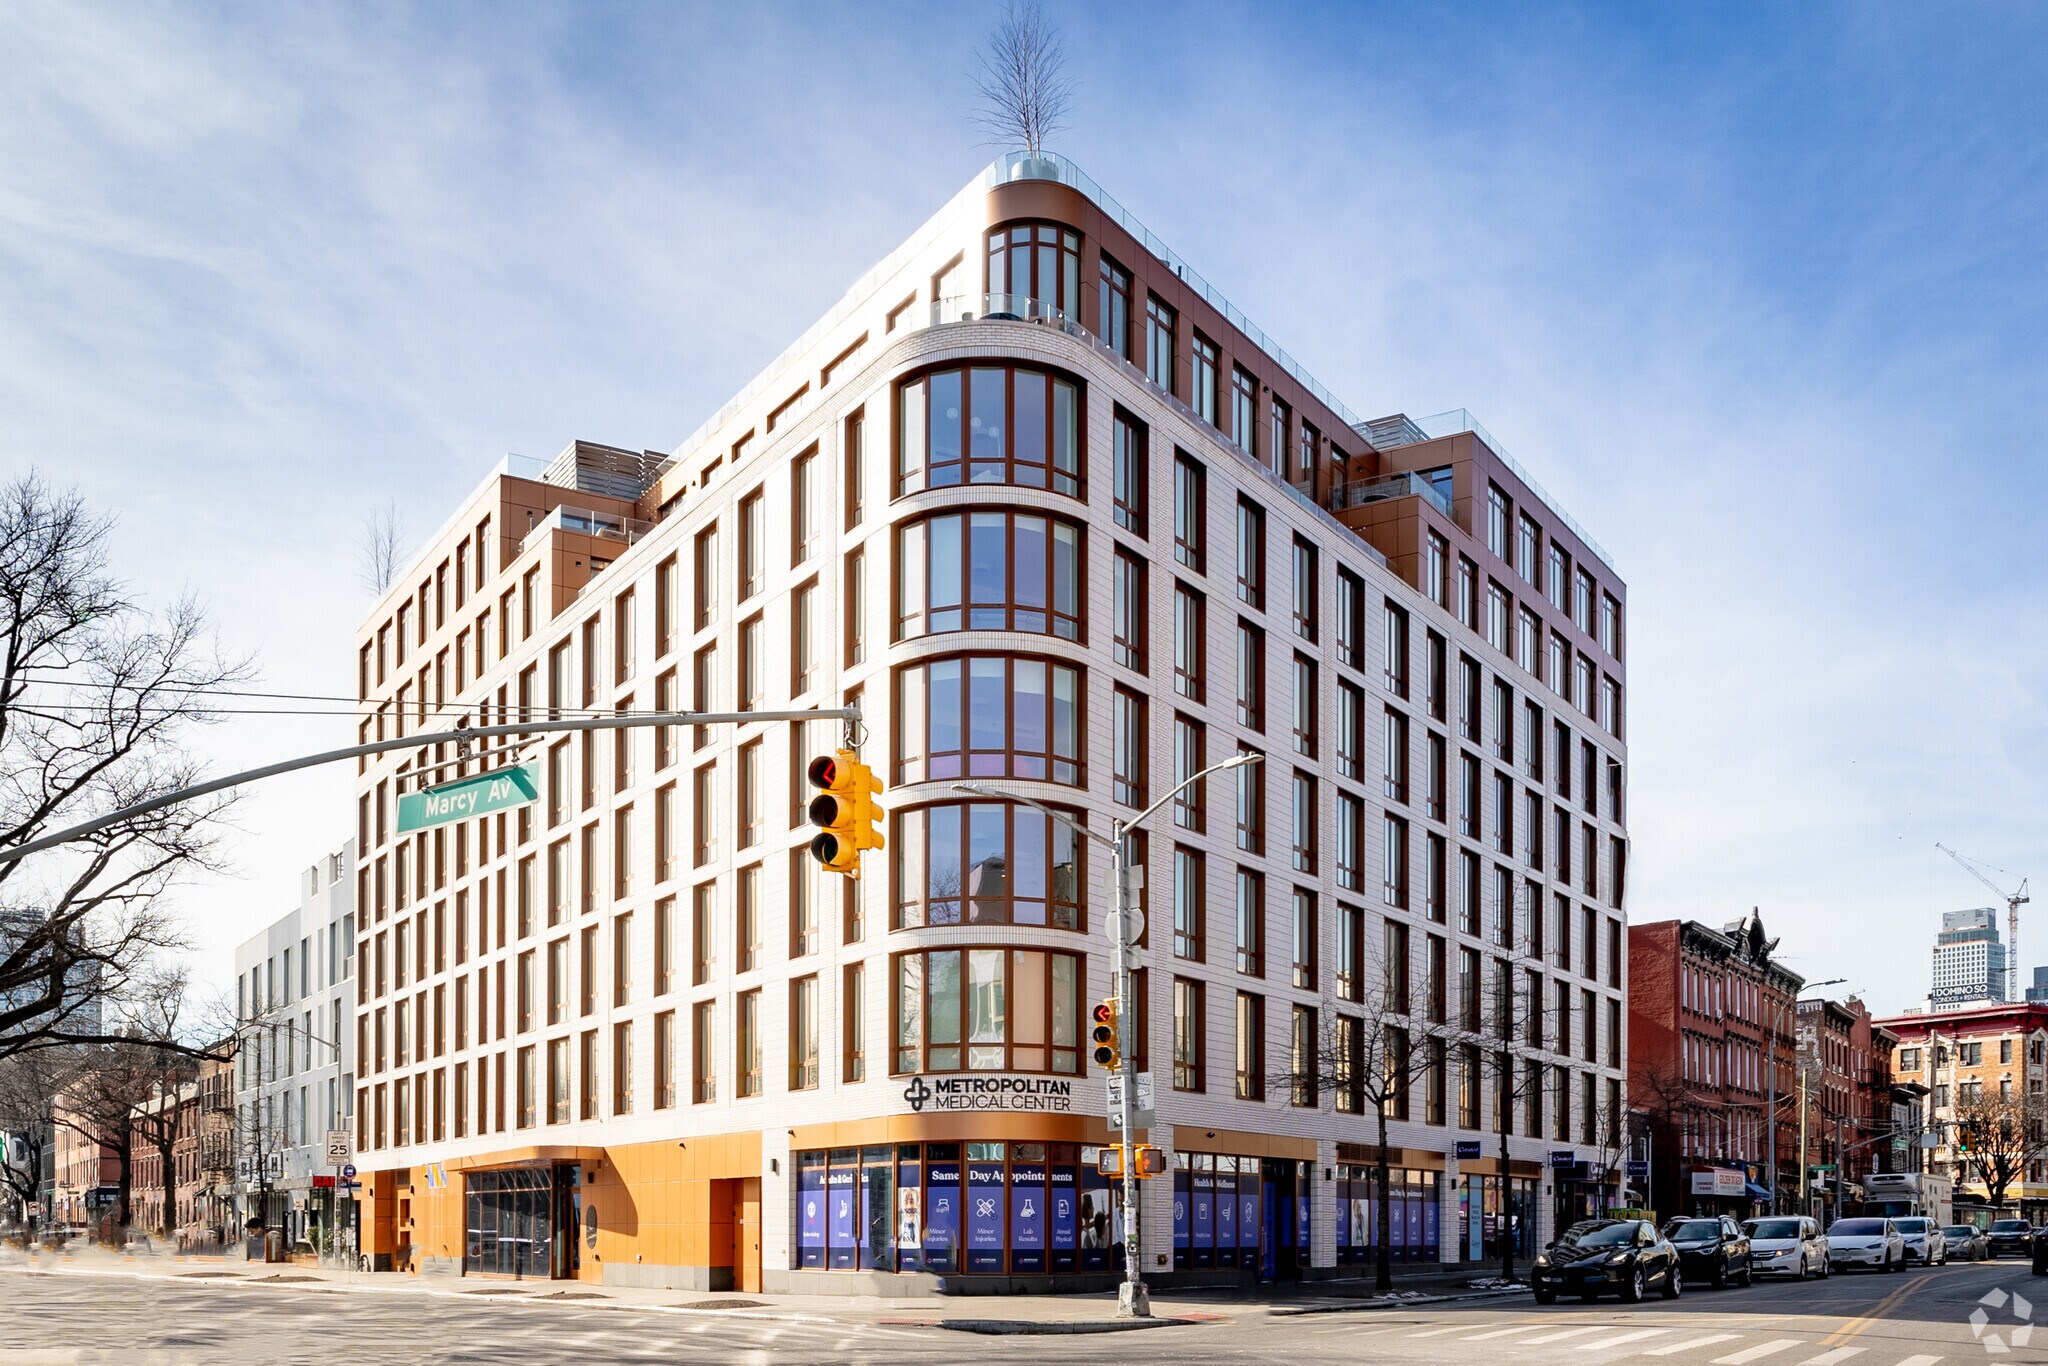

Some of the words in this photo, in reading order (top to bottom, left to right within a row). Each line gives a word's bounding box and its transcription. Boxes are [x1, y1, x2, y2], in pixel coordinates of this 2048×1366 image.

[425, 790, 478, 818] Marcy
[487, 780, 512, 802] Av
[1936, 986, 1973, 997] DOMINO
[1974, 984, 1988, 993] SQ
[935, 1078, 1071, 1096] METROPOLITAN
[935, 1094, 1009, 1109] MEDICAL
[1011, 1094, 1071, 1111] CENTER
[330, 1145, 347, 1155] 25
[932, 1170, 959, 1181] Same
[969, 1170, 989, 1183] Day
[992, 1170, 1073, 1182] Appointments
[1194, 1178, 1209, 1187] Health
[1055, 1235, 1073, 1243] Physical
